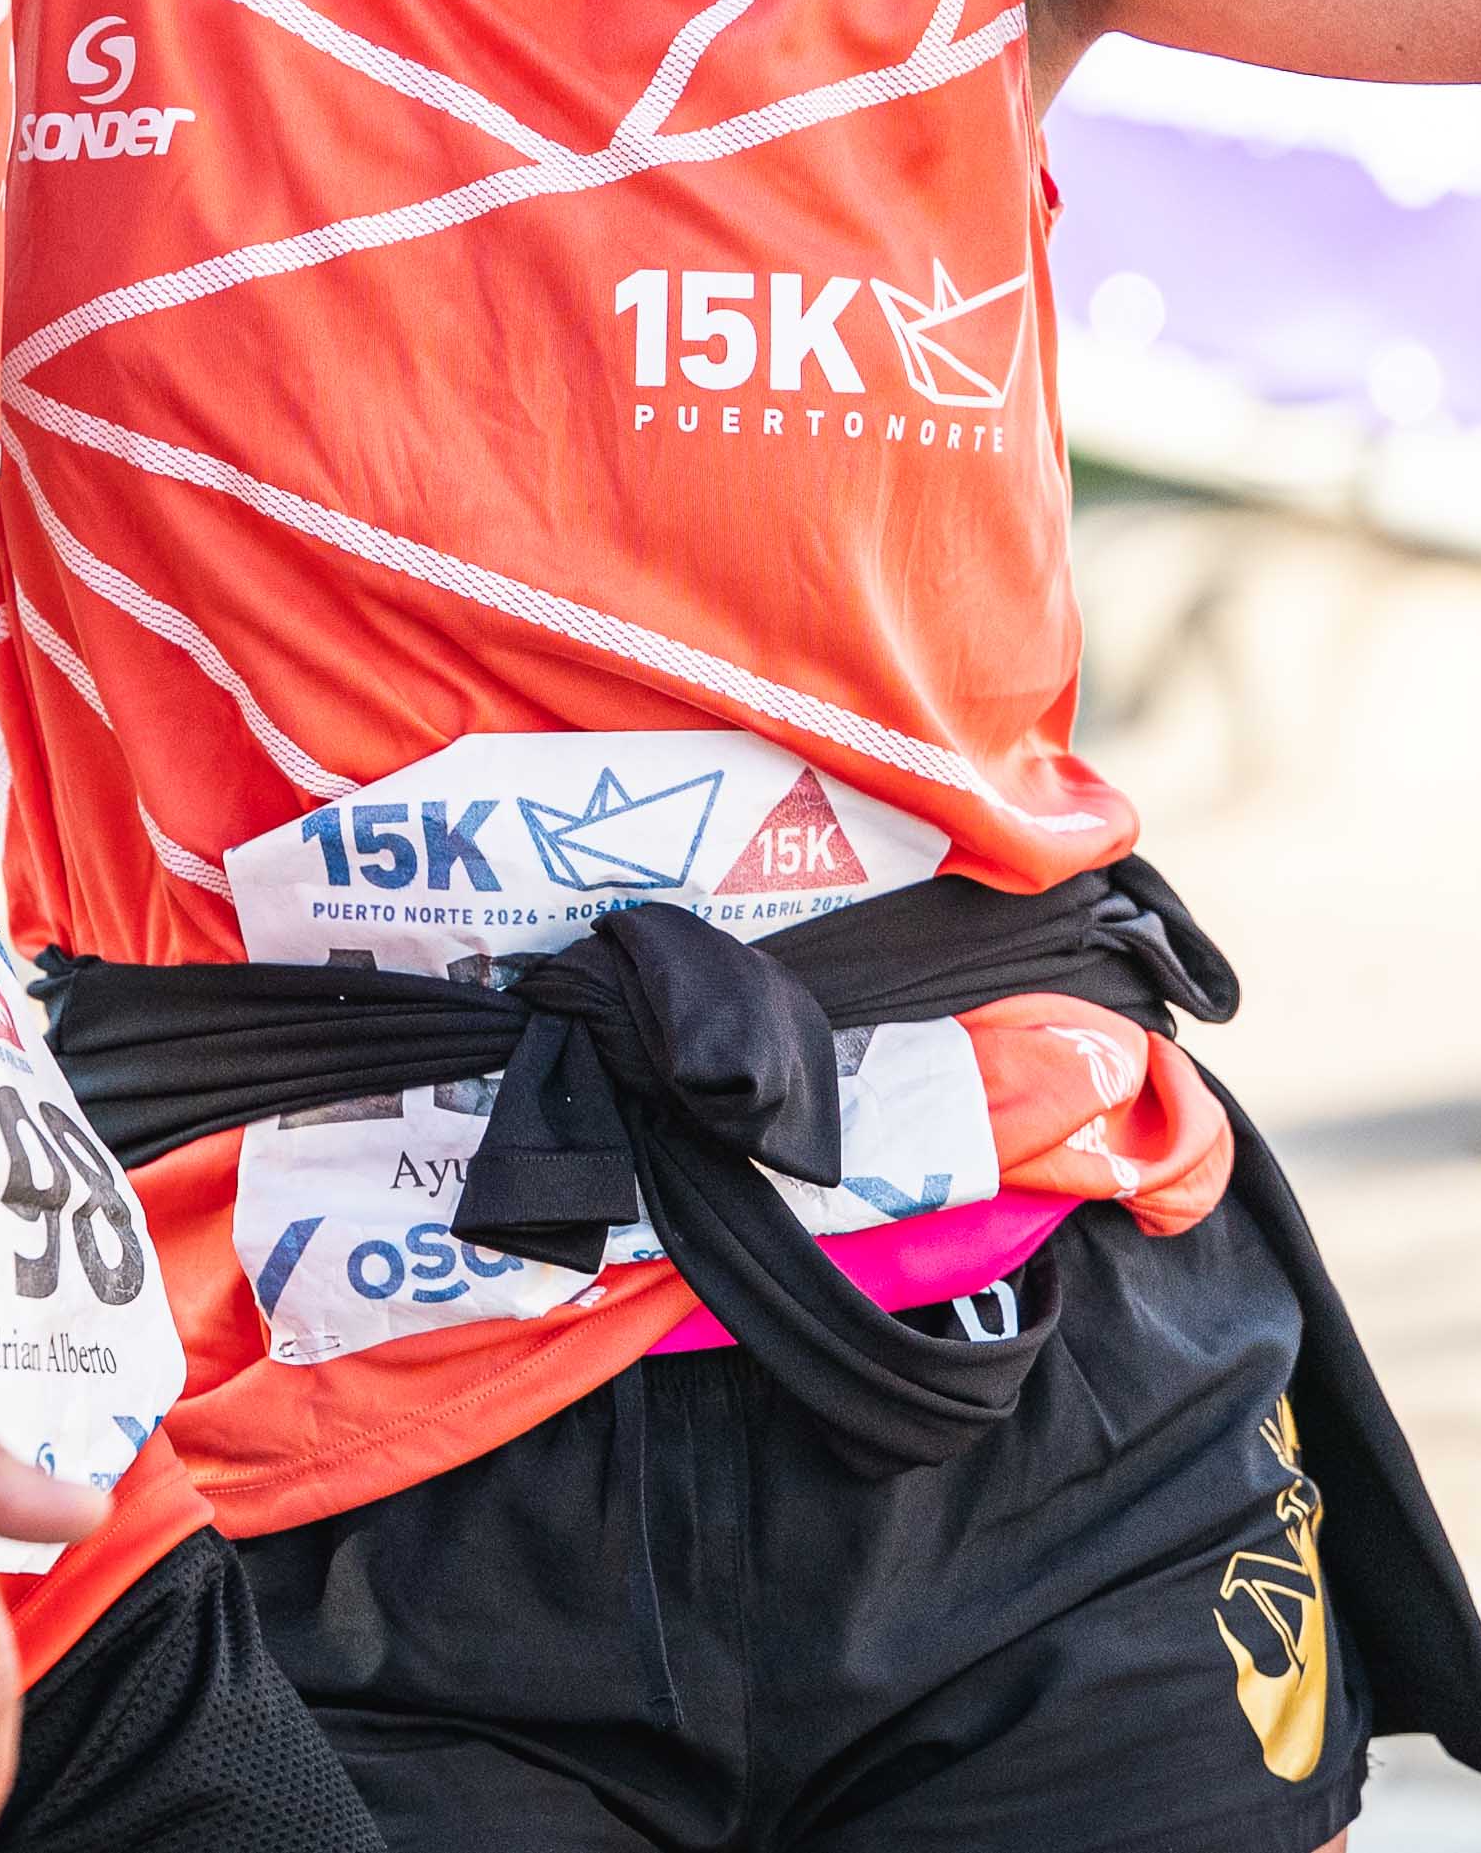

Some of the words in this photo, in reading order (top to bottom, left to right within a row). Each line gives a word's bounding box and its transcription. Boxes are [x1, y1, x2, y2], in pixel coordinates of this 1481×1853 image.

[615, 269, 866, 393] 15K
[635, 404, 864, 438] PUERTO
[886, 413, 1004, 453] NORTE
[301, 799, 503, 892] 15K
[757, 824, 838, 877] 15K
[313, 902, 395, 922] PUERTO
[404, 904, 473, 925] NORTE
[484, 908, 537, 926] 2026
[721, 904, 746, 920] DE
[752, 900, 804, 920] ABRIL
[389, 1150, 470, 1198] Ayu
[47, 1332, 117, 1374] Alberto
